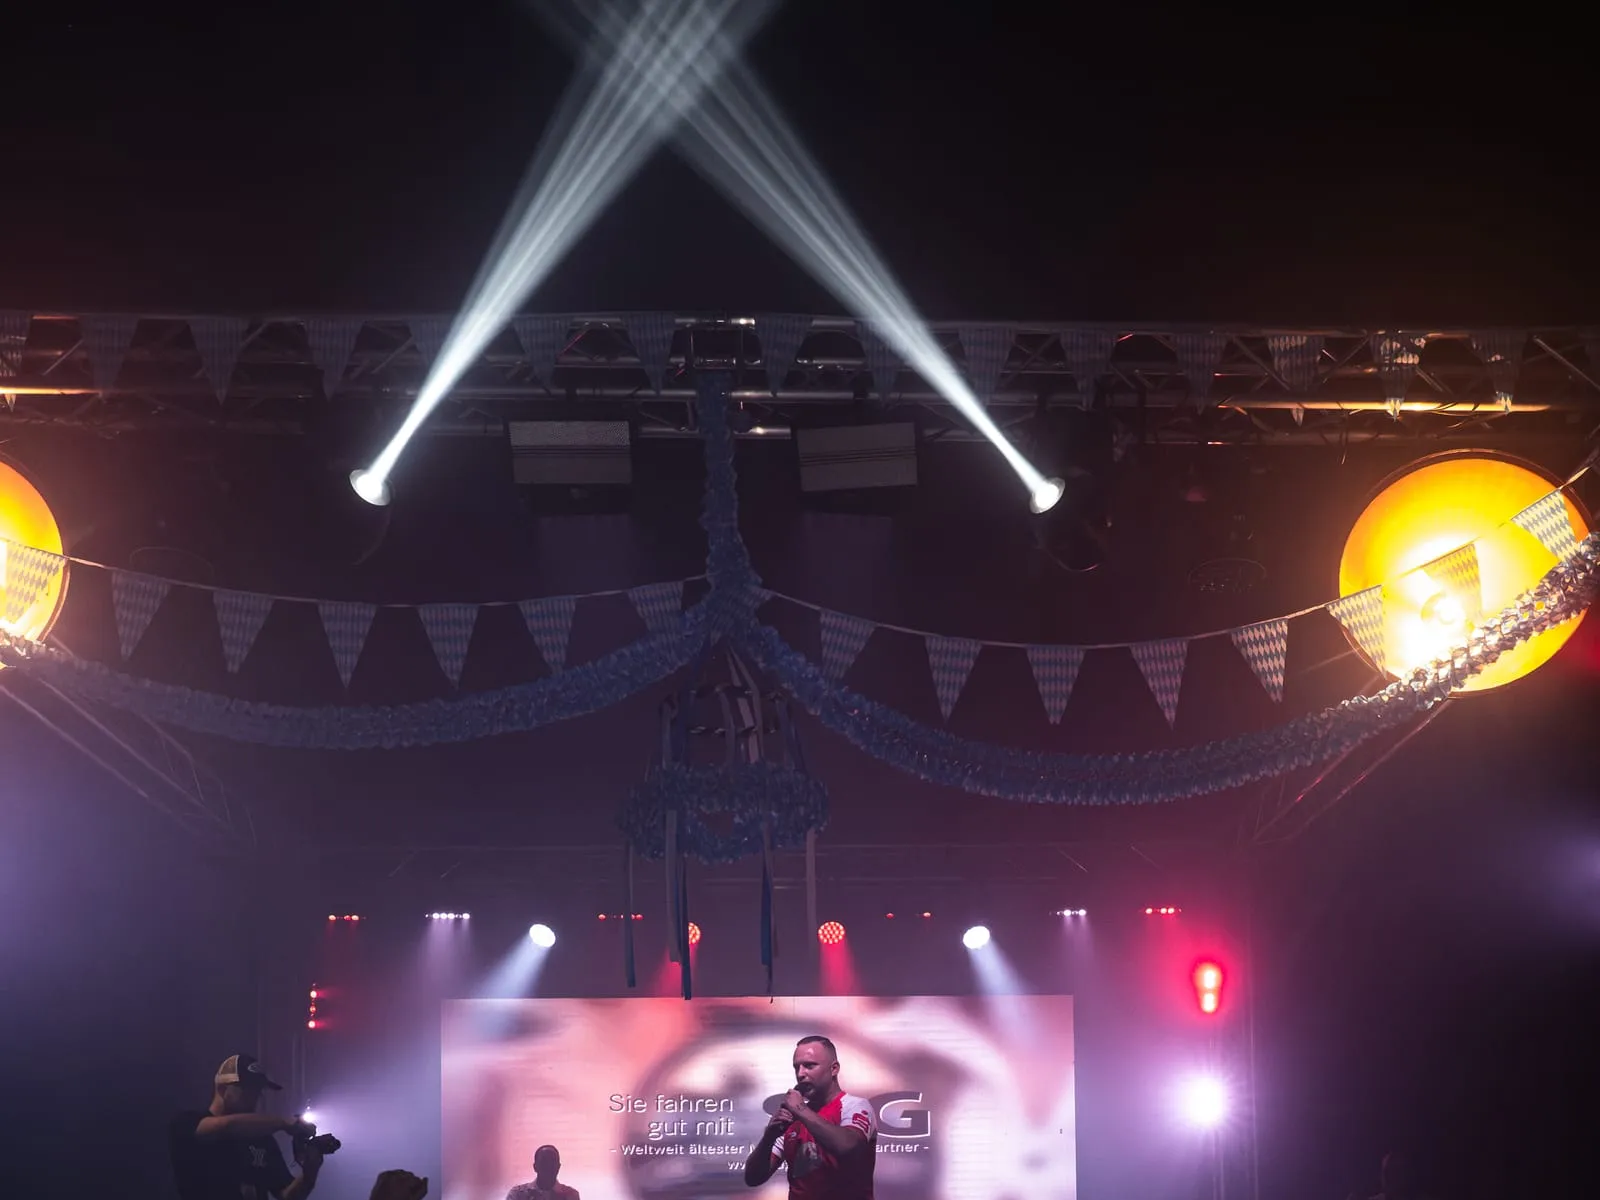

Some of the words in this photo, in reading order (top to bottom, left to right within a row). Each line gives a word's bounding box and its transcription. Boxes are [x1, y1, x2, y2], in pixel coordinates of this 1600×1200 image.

[609, 1093, 647, 1113] Sie
[656, 1094, 734, 1113] fahren
[648, 1118, 688, 1140] gut
[696, 1117, 735, 1136] mit
[621, 1143, 685, 1156] Weltweit
[688, 1143, 745, 1155] ältester
